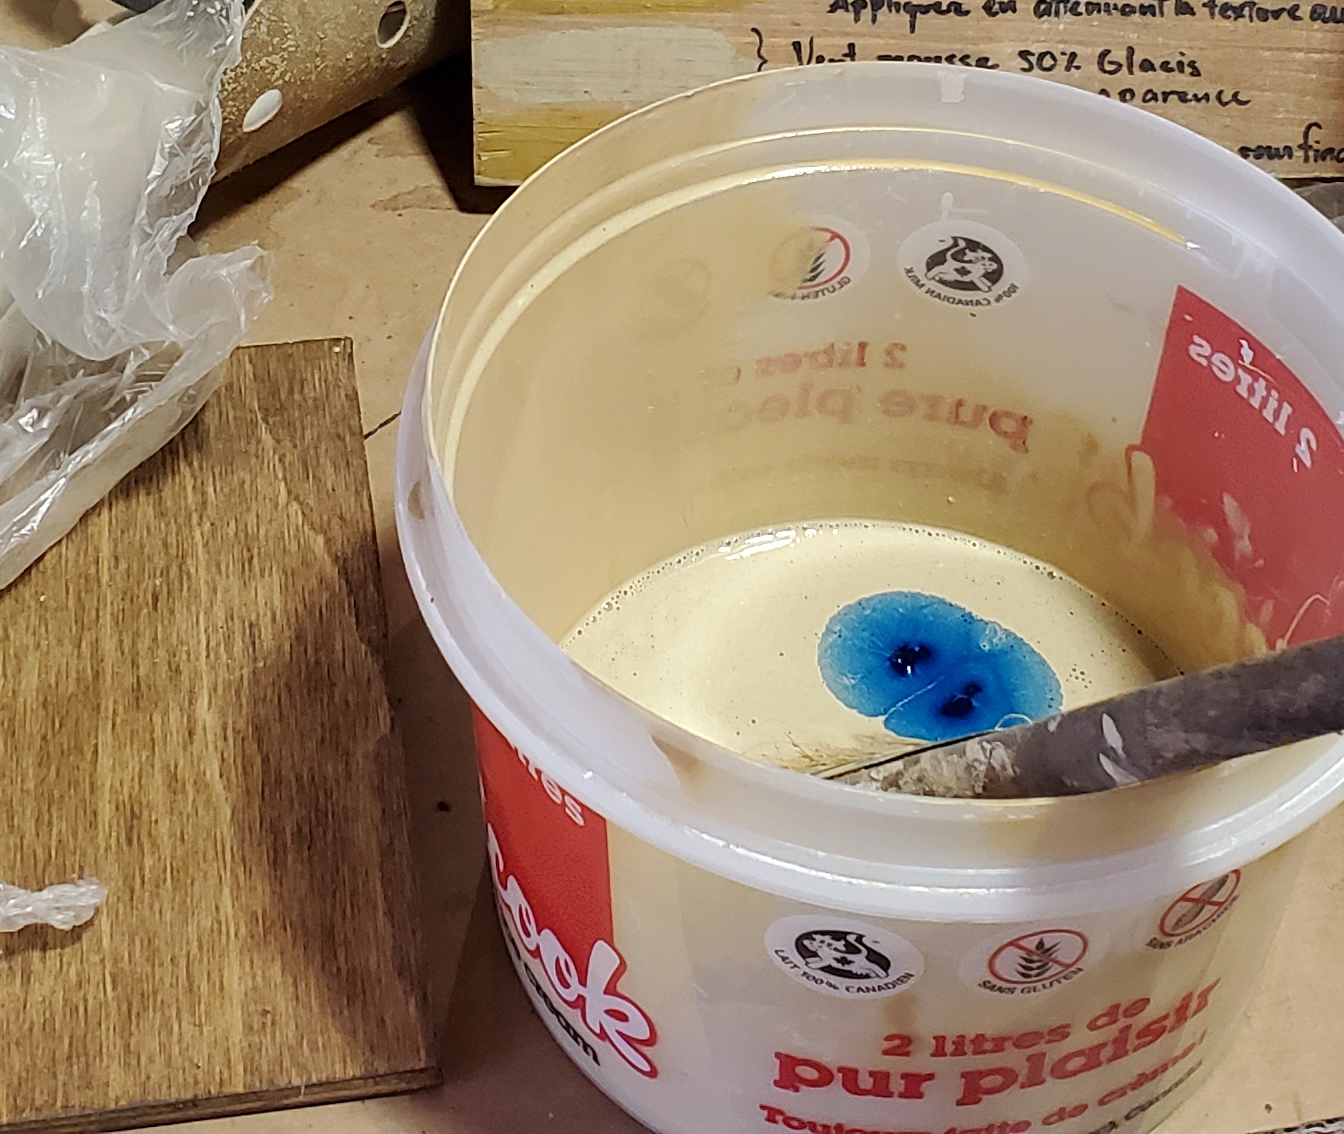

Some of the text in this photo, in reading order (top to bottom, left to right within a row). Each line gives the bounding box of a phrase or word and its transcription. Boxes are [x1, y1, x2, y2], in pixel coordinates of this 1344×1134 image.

[774, 949, 801, 970] LAIT
[845, 972, 915, 993] CANADIEN
[977, 967, 1084, 995] SANS GLUTEN
[773, 1052, 935, 1100] pur
[955, 976, 1222, 1107] plaisir
[881, 997, 1151, 1058] 2 litres de
